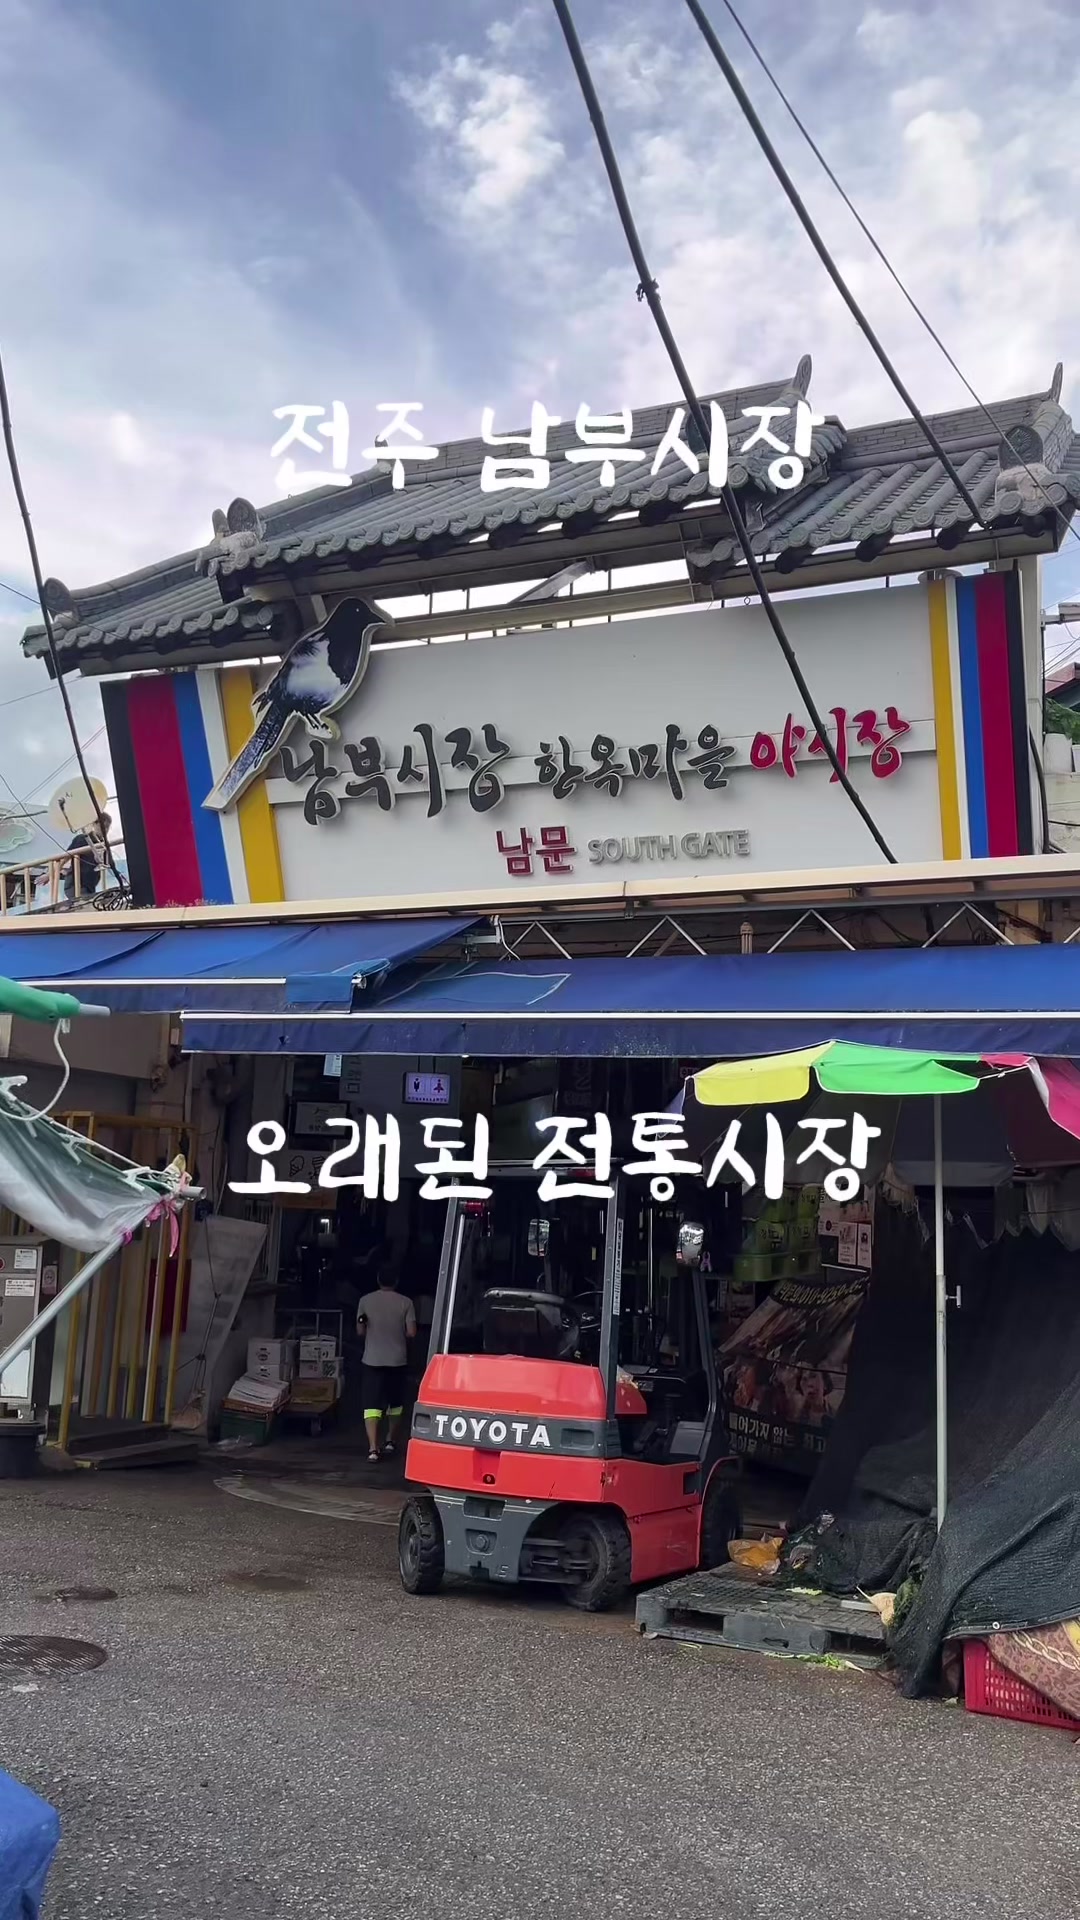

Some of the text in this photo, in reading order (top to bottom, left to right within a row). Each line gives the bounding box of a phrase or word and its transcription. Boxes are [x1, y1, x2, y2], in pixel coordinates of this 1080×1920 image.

[280, 706, 911, 826] 남부시장 한옥마을 야시장
[495, 825, 577, 875] 남문
[587, 828, 750, 865] SOUTH GATE
[435, 1414, 551, 1448] TOYOTA
